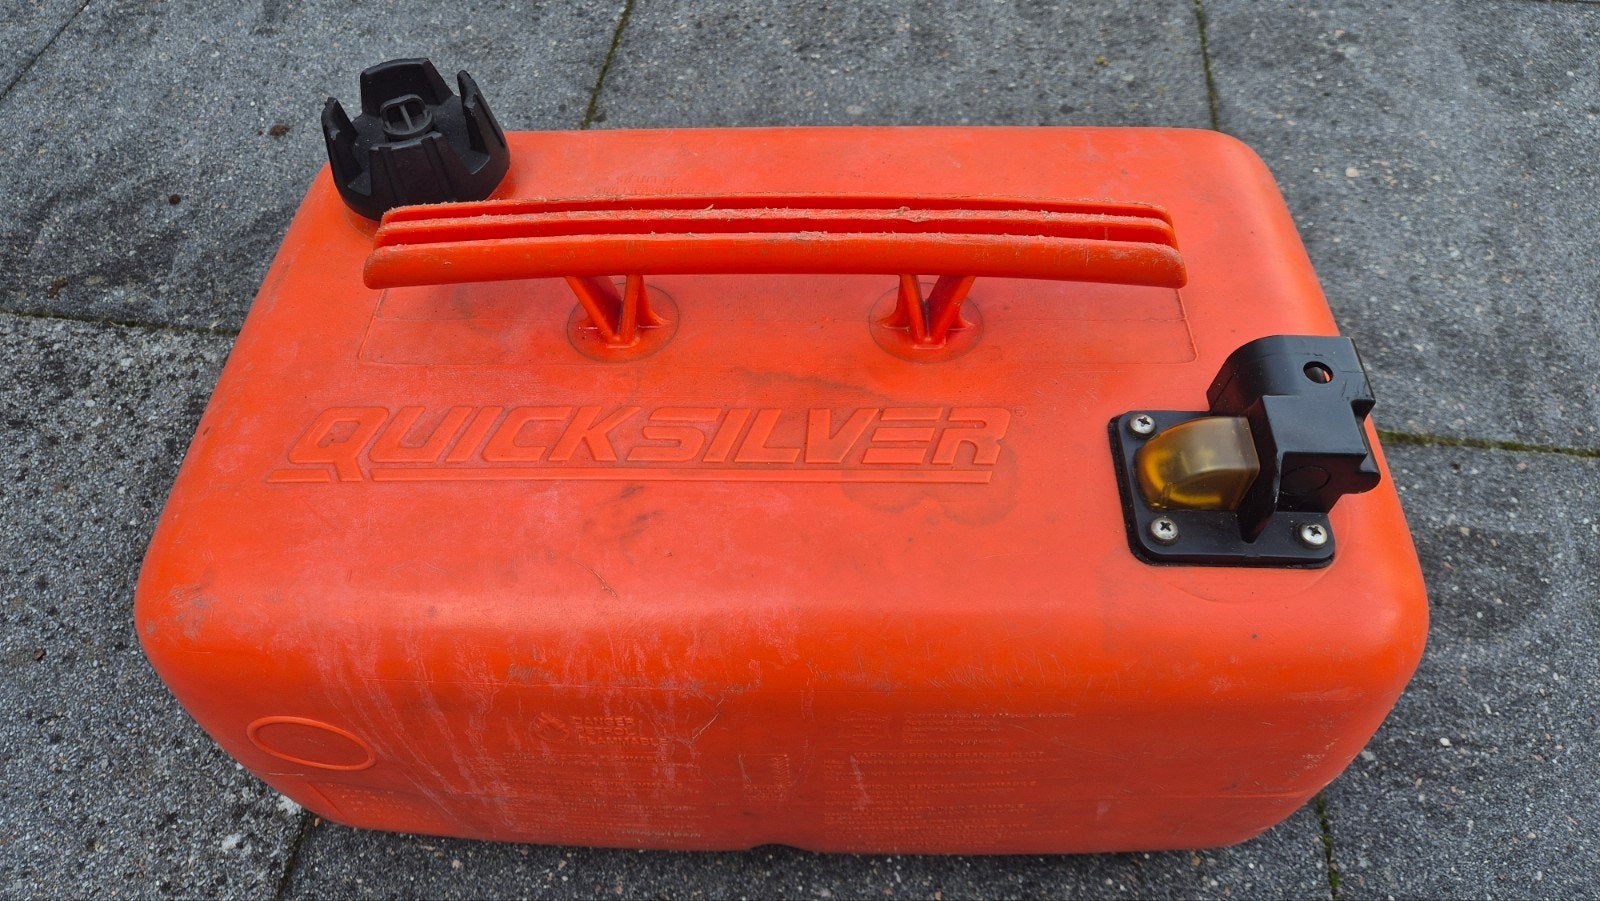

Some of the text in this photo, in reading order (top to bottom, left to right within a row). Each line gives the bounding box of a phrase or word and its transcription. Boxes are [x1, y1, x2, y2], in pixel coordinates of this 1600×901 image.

[287, 405, 1011, 482] QUICKSILVER
[572, 715, 634, 726] DANGER
[576, 727, 636, 736] PETROL
[579, 735, 669, 746] FLAMMABLE
